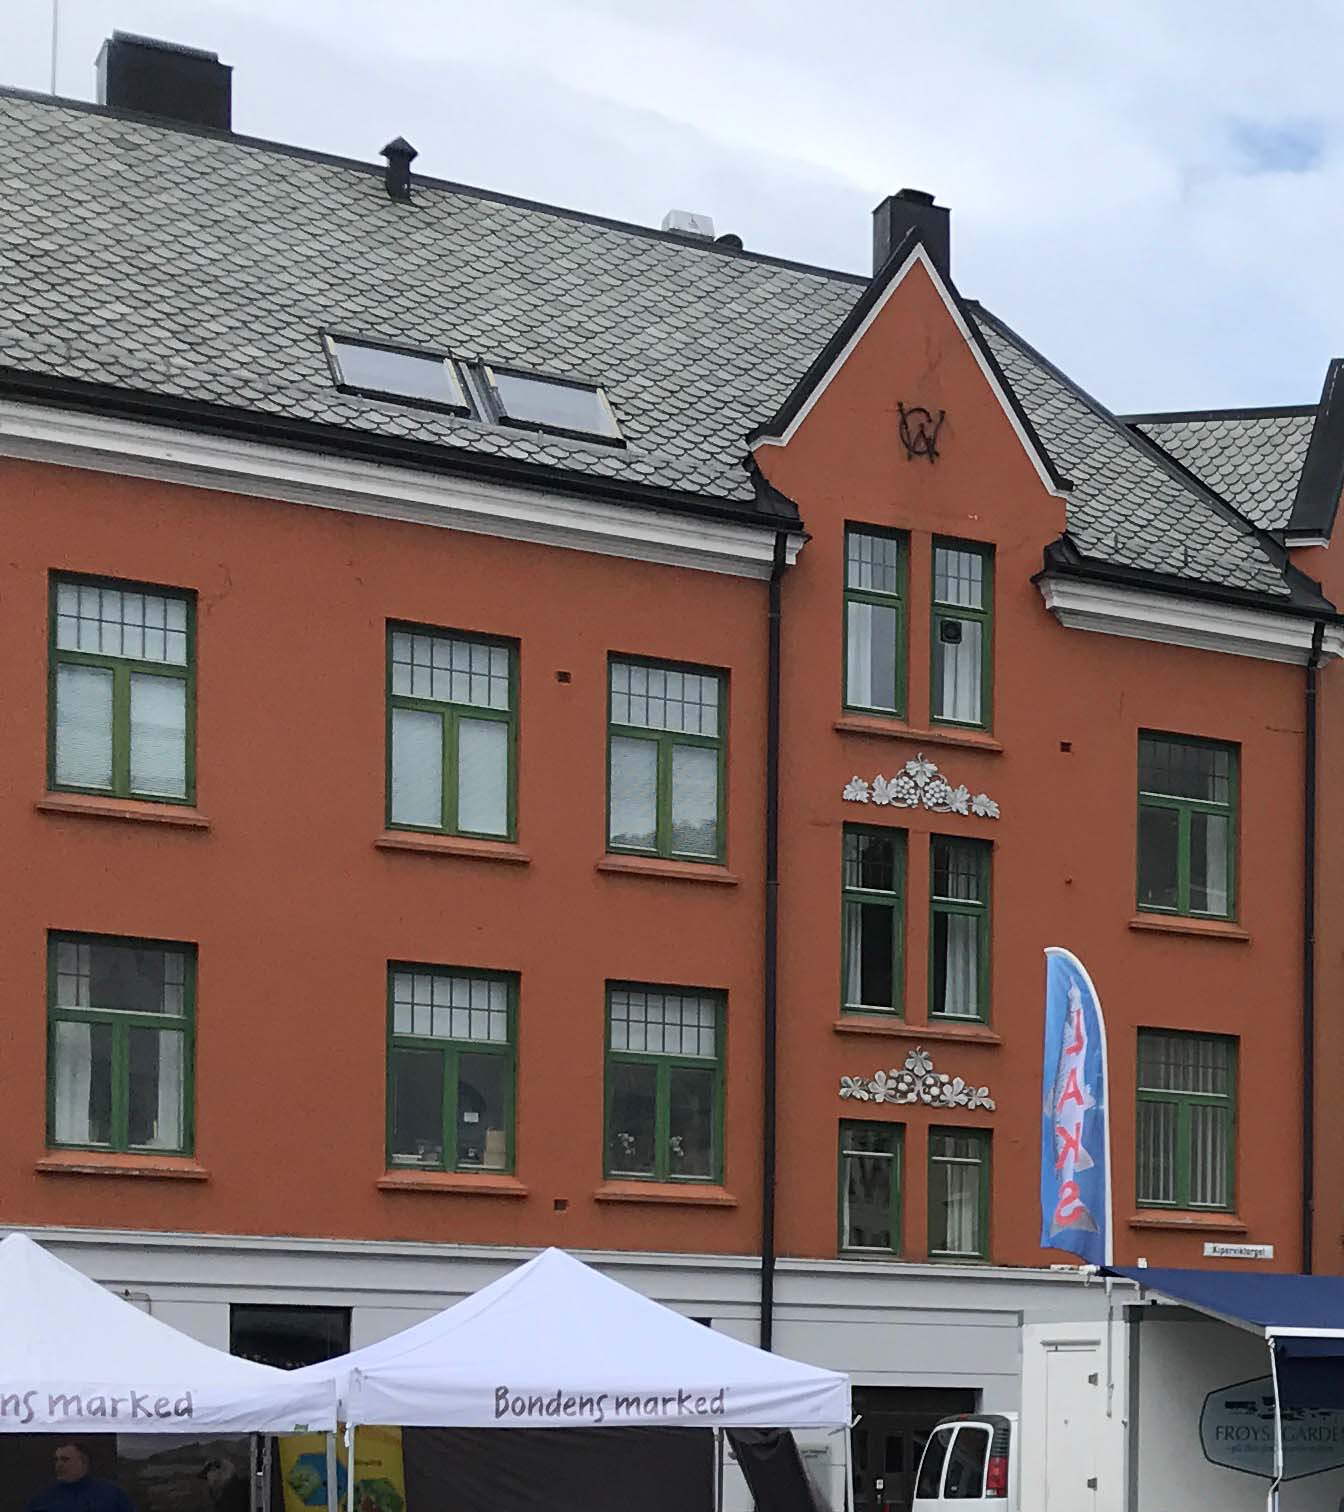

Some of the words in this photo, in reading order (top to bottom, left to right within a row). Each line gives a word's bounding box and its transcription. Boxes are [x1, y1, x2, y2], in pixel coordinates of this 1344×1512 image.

[48, 1390, 194, 1418] marked
[495, 1385, 609, 1424] Bondens
[615, 1388, 725, 1416] marked
